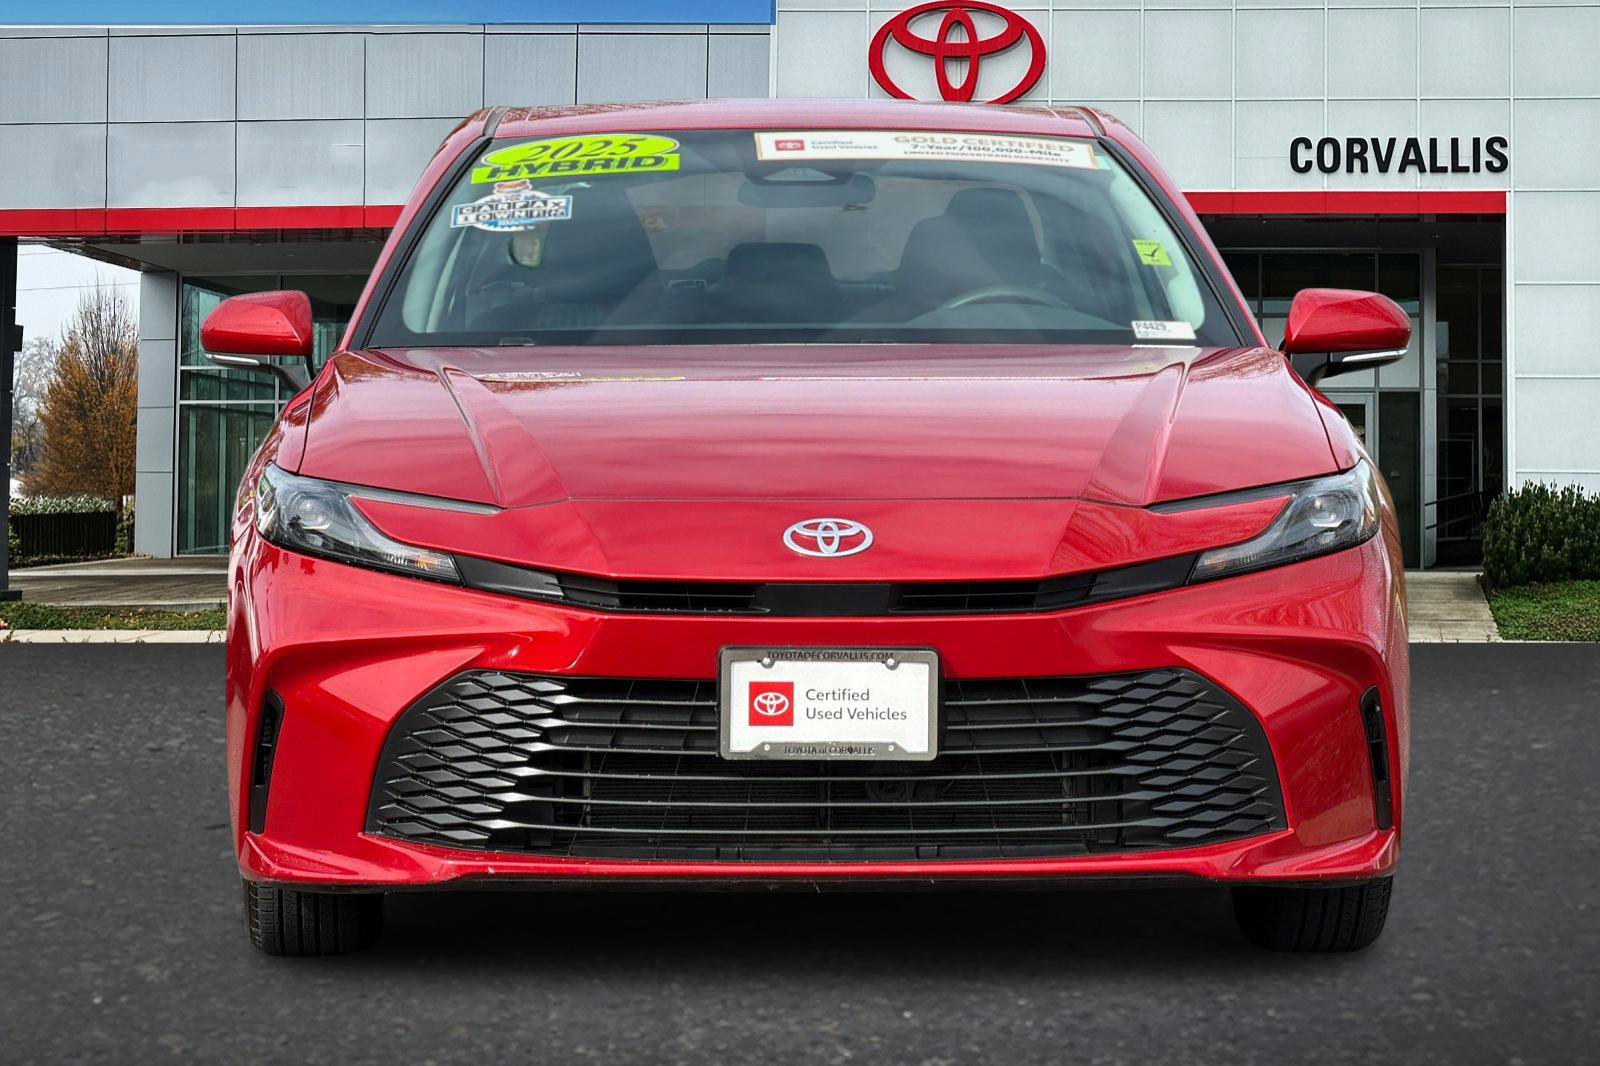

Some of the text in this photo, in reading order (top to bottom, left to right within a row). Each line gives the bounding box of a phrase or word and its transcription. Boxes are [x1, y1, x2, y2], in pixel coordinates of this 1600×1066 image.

[516, 137, 648, 164] 2025
[894, 136, 1075, 152] GOLD CERTIFIED
[1290, 136, 1509, 174] CORVALLIS
[486, 155, 667, 179] HYBRID
[459, 199, 566, 215] CARFAX
[767, 651, 894, 661] TOYOTAOFCORVALLIS.COM
[805, 688, 870, 701] Certified
[805, 707, 907, 720] Used Vehicles
[784, 746, 817, 755] TOYOTA
[829, 746, 875, 755] CORVALLIS
